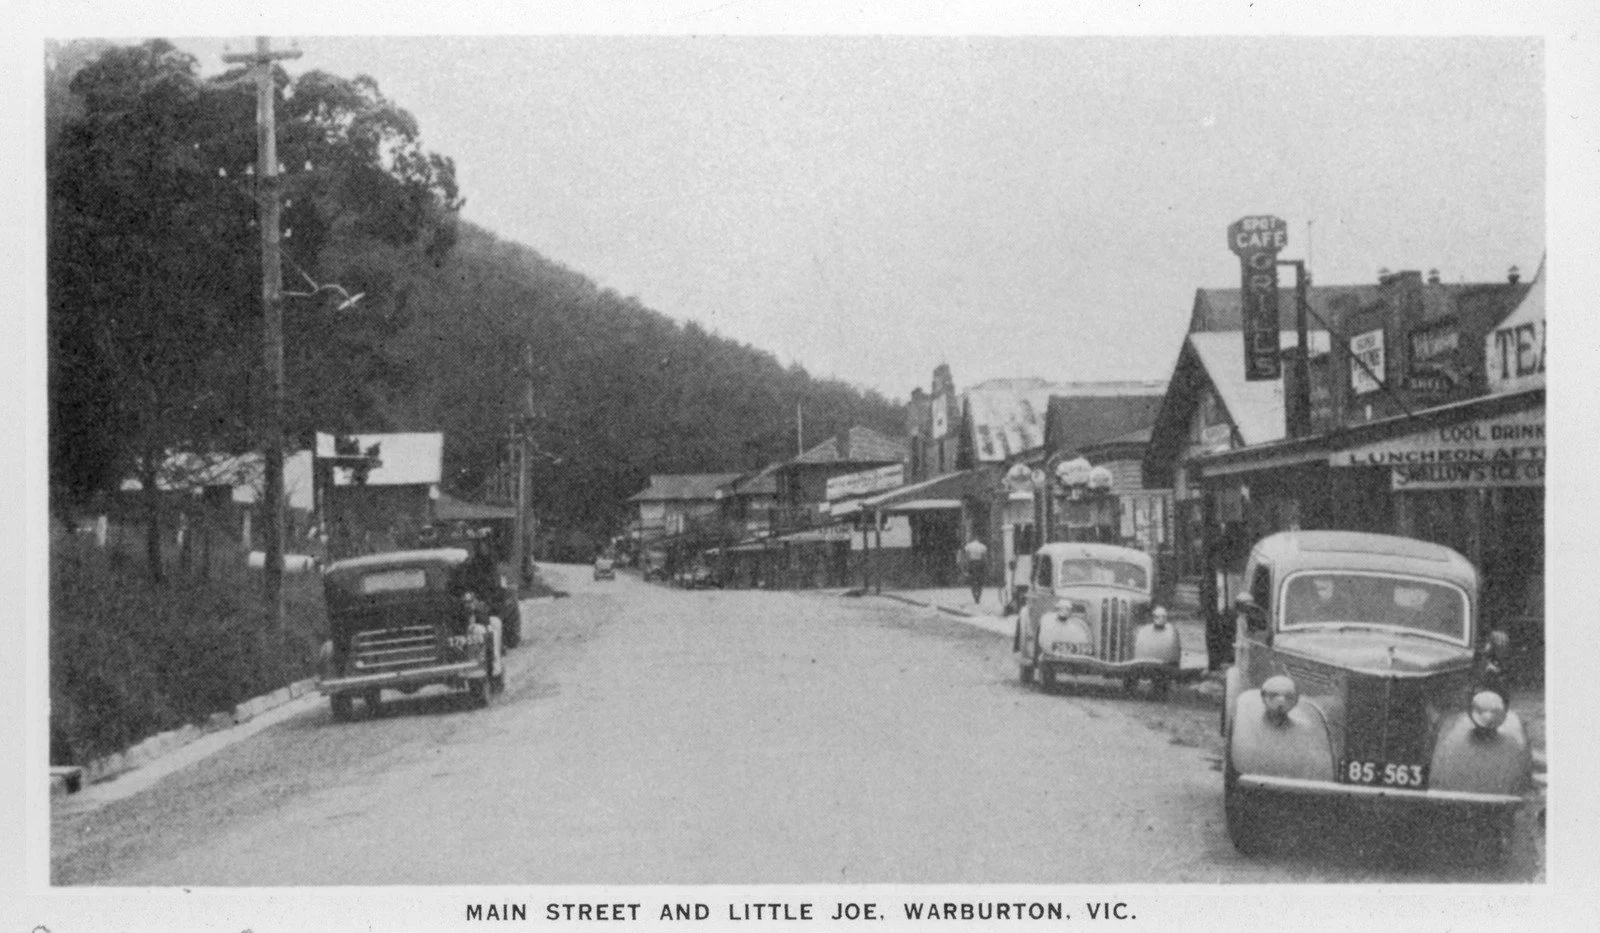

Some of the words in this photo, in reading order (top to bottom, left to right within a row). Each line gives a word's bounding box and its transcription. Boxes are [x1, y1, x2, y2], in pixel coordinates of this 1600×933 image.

[1236, 230, 1285, 248] CAFE
[1440, 425, 1487, 441] COOL
[1350, 449, 1485, 465] LUNCHEON
